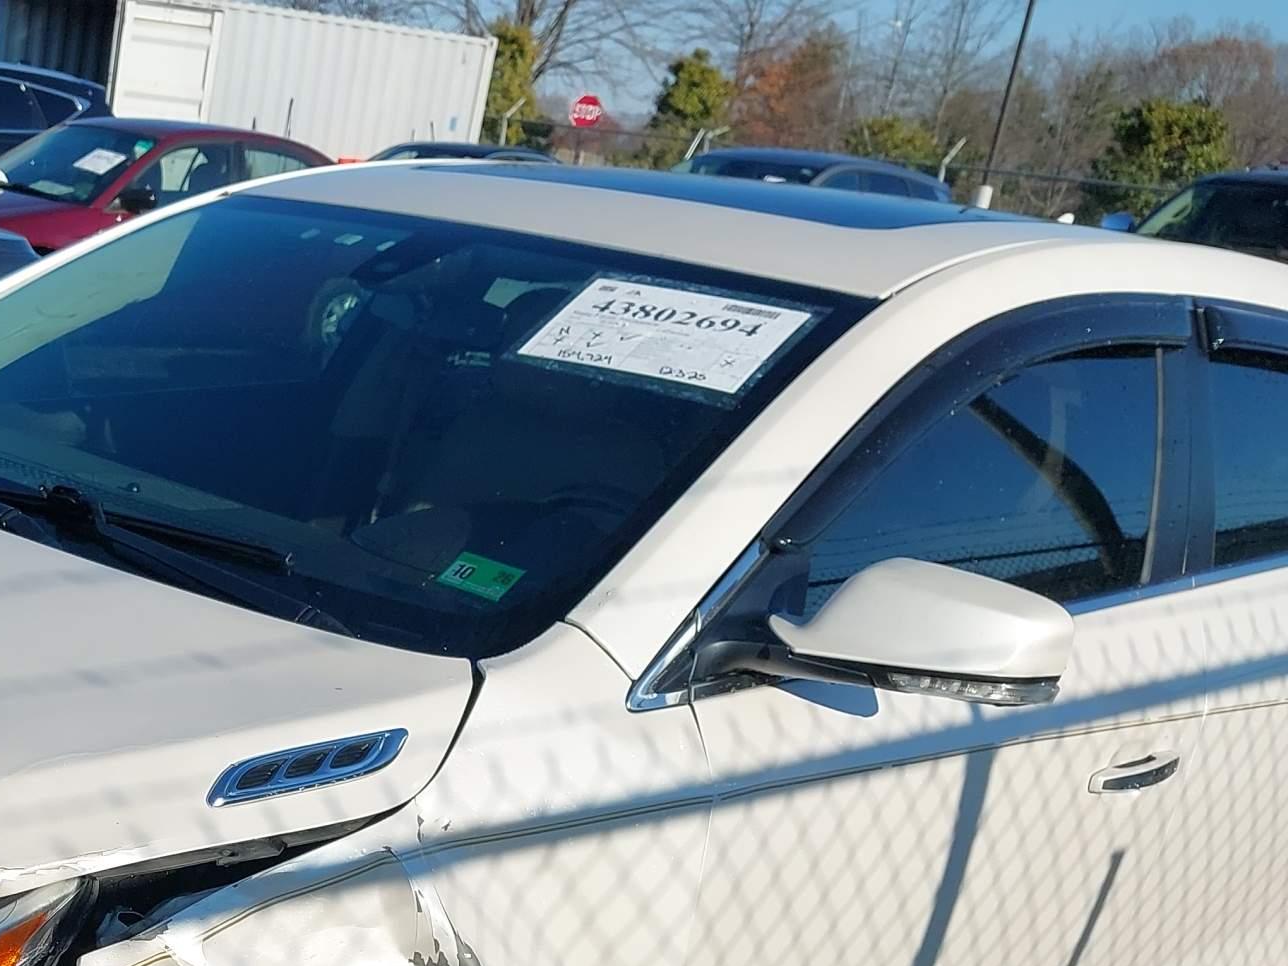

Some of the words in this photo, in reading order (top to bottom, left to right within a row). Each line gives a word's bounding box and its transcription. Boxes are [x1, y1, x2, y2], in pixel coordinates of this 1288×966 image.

[574, 103, 601, 120] STOP
[592, 299, 764, 337] 43802694
[453, 564, 476, 579] 10
